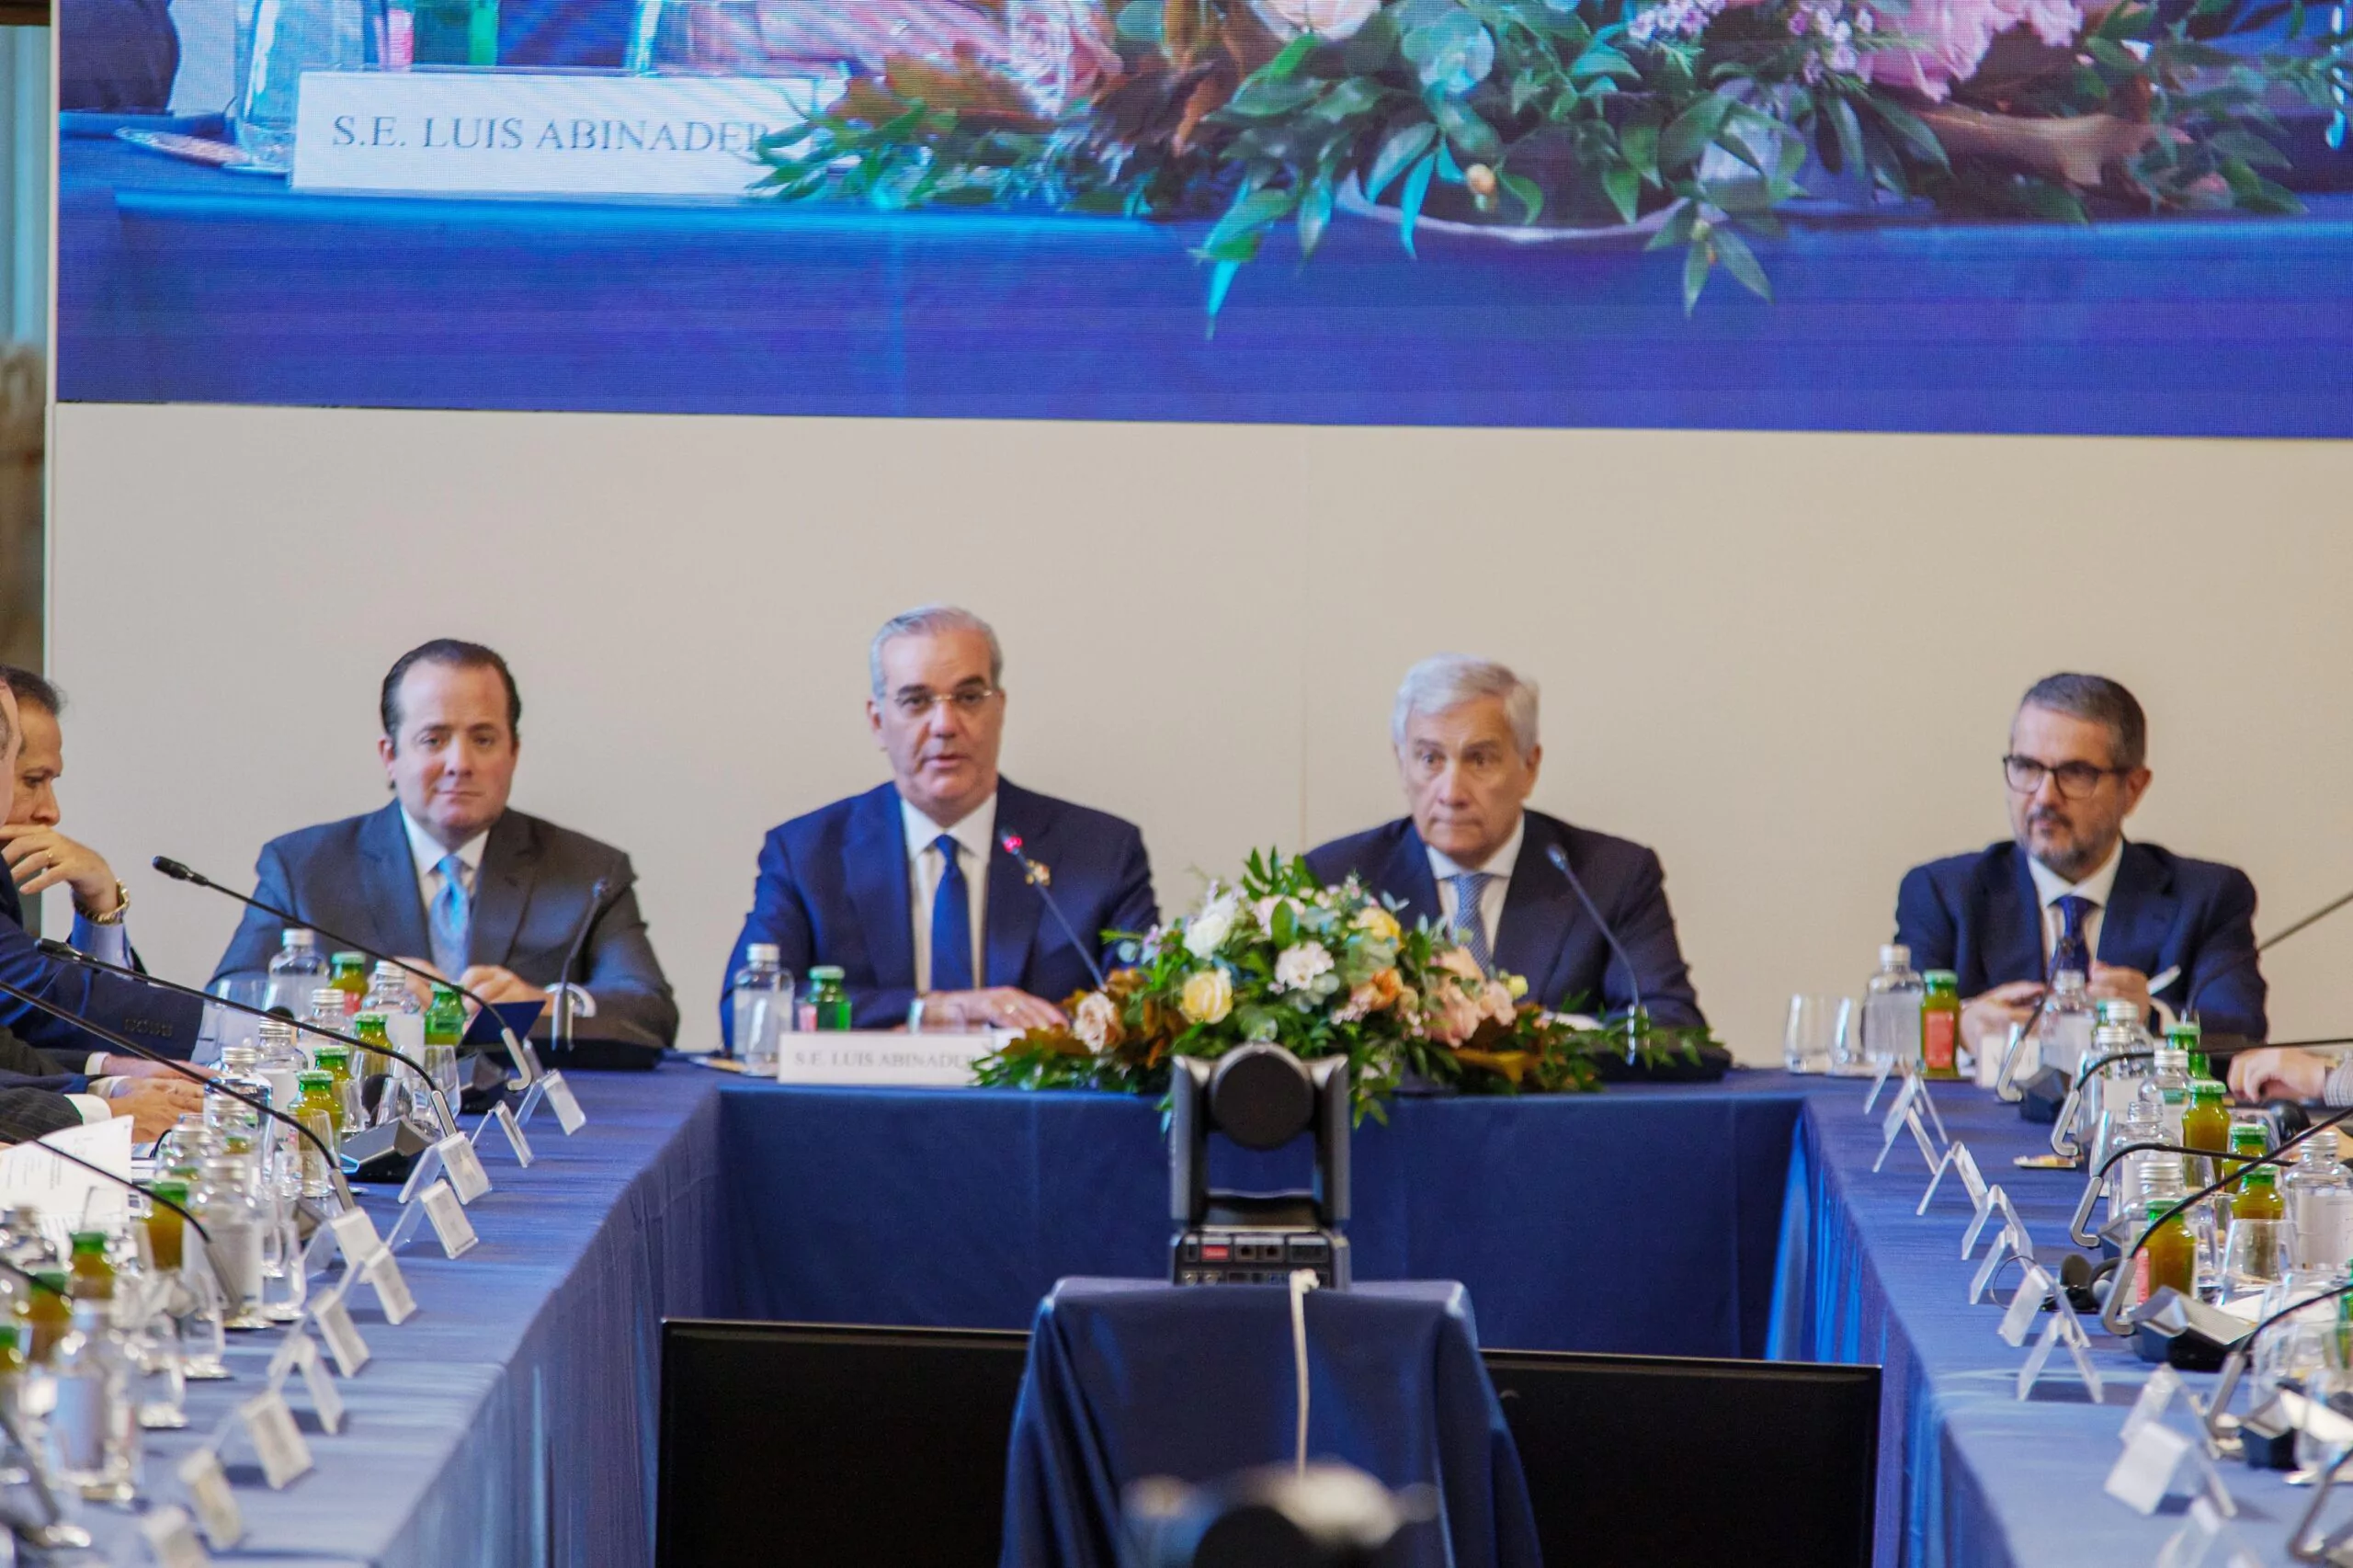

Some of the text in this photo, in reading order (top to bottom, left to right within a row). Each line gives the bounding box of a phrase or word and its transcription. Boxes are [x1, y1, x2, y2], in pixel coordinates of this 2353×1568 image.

[332, 114, 406, 147] S.E.
[423, 117, 523, 150] LUIS
[831, 1051, 874, 1068] LUIS
